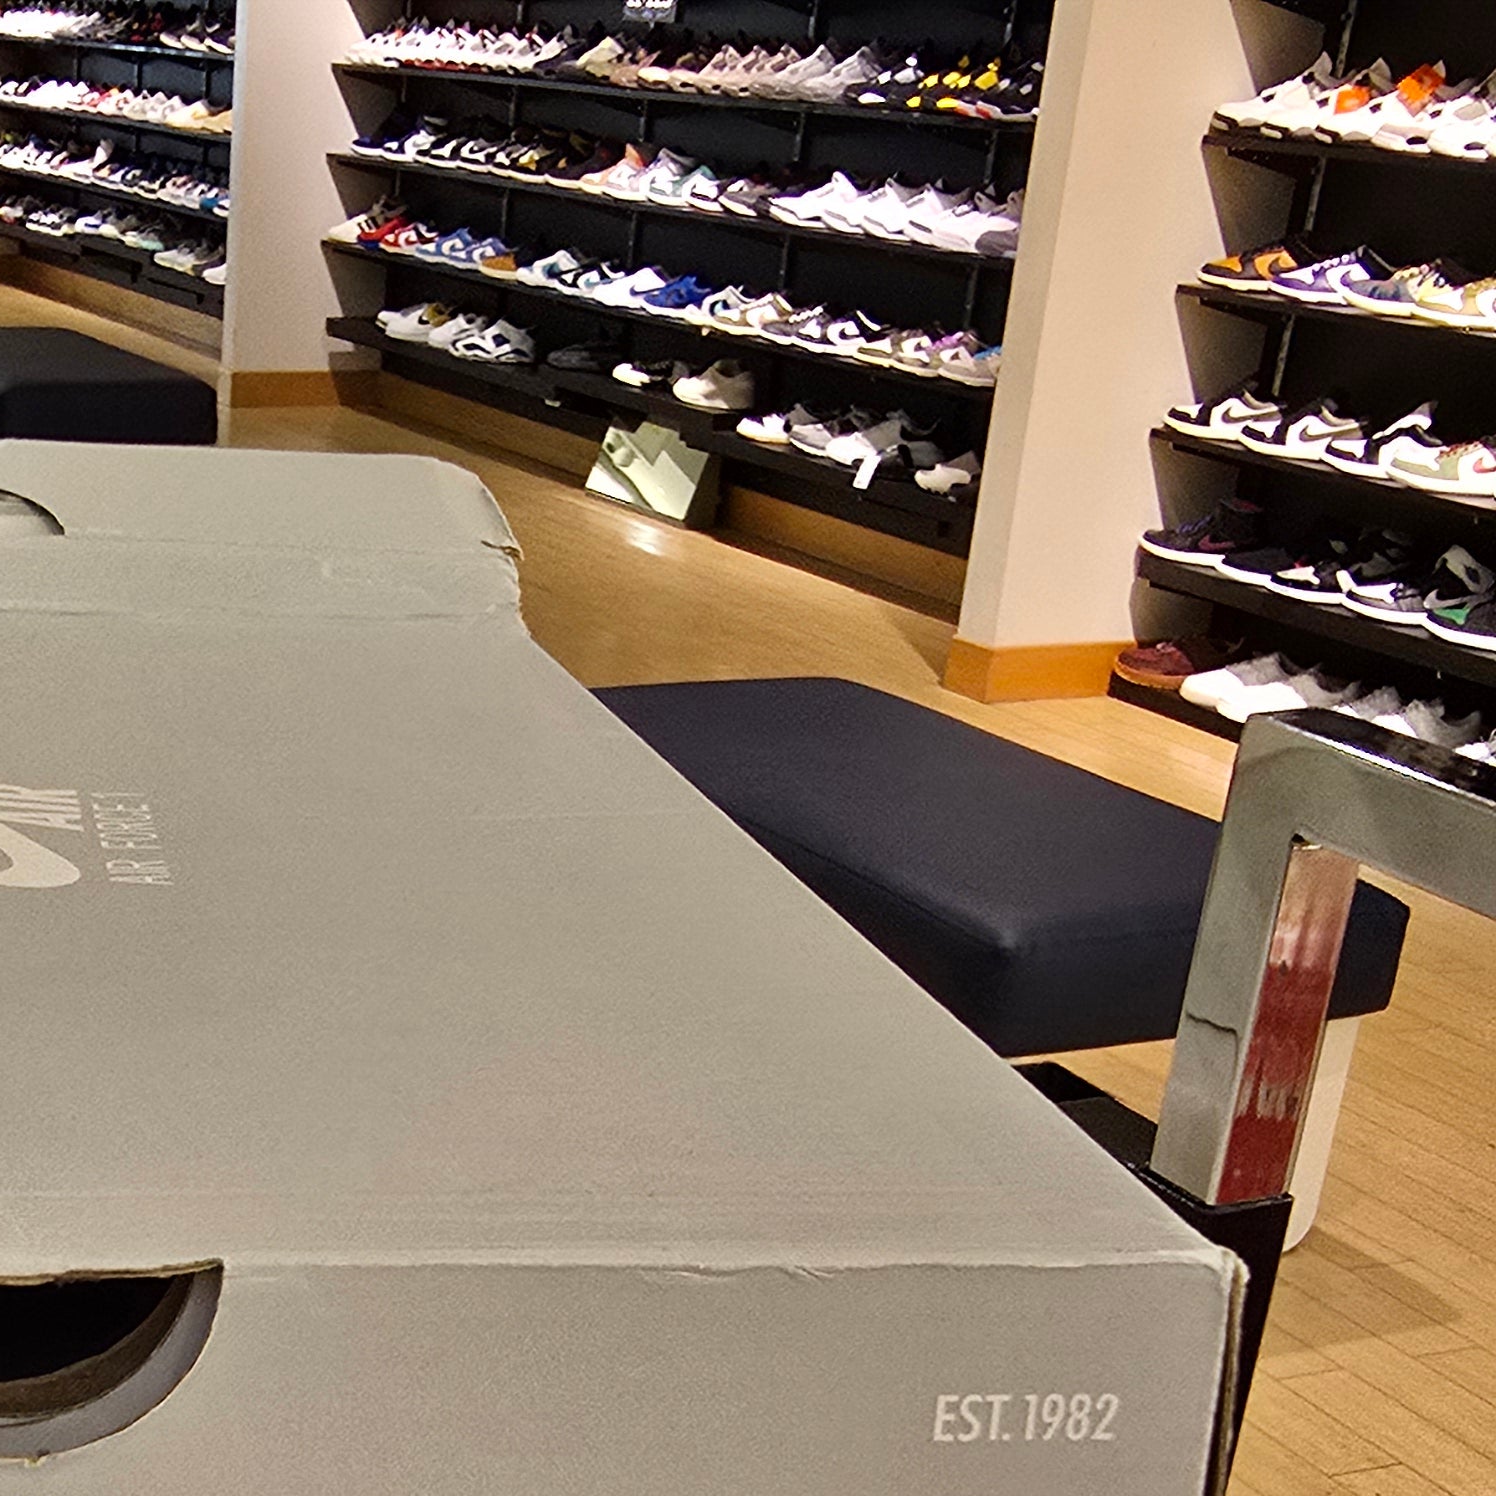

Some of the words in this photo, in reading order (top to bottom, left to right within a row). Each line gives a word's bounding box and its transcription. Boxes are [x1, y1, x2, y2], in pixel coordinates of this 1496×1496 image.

[91, 802, 163, 849] FORCE
[933, 1394, 1012, 1442] EST.
[1022, 1393, 1120, 1442] 1982
